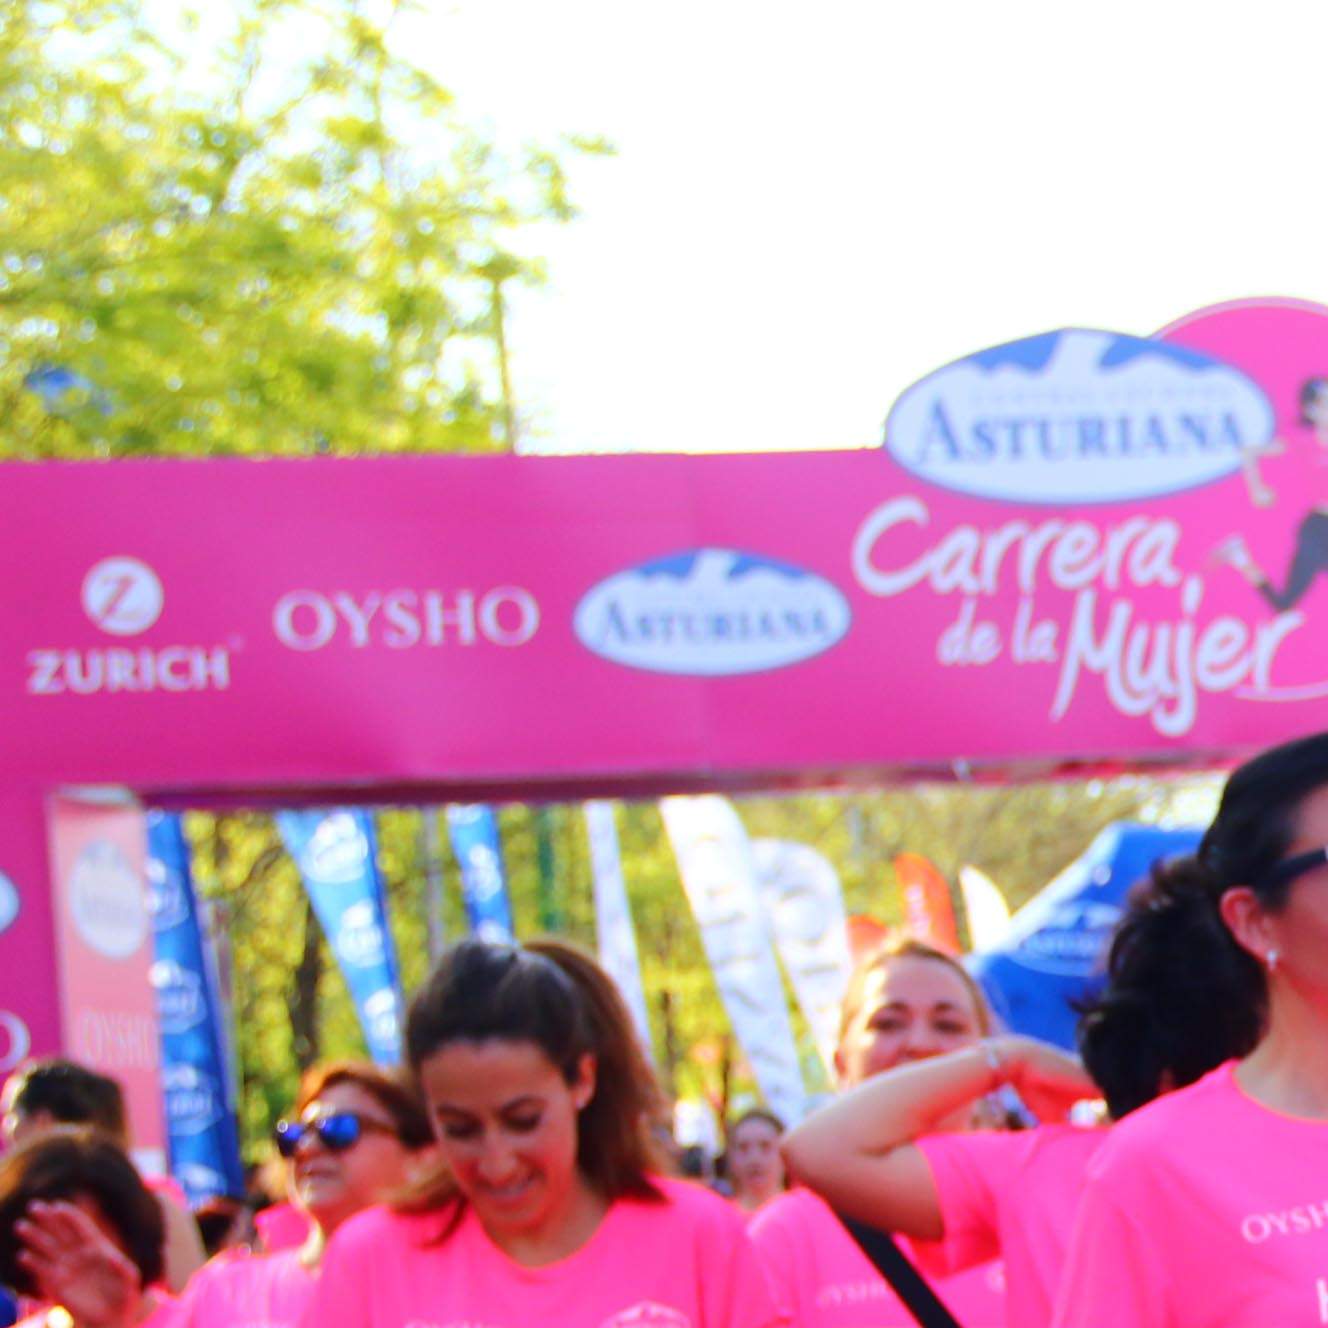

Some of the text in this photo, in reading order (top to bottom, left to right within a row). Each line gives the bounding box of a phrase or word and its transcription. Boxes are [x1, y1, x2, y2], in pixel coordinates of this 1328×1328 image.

[915, 398, 1246, 464] ASTURIANA
[852, 496, 1180, 596] Carrera
[273, 586, 540, 651] OYSHO
[596, 598, 834, 646] ASTURIANA
[27, 646, 231, 693] ZURICH
[938, 574, 1304, 736] de la Mujer
